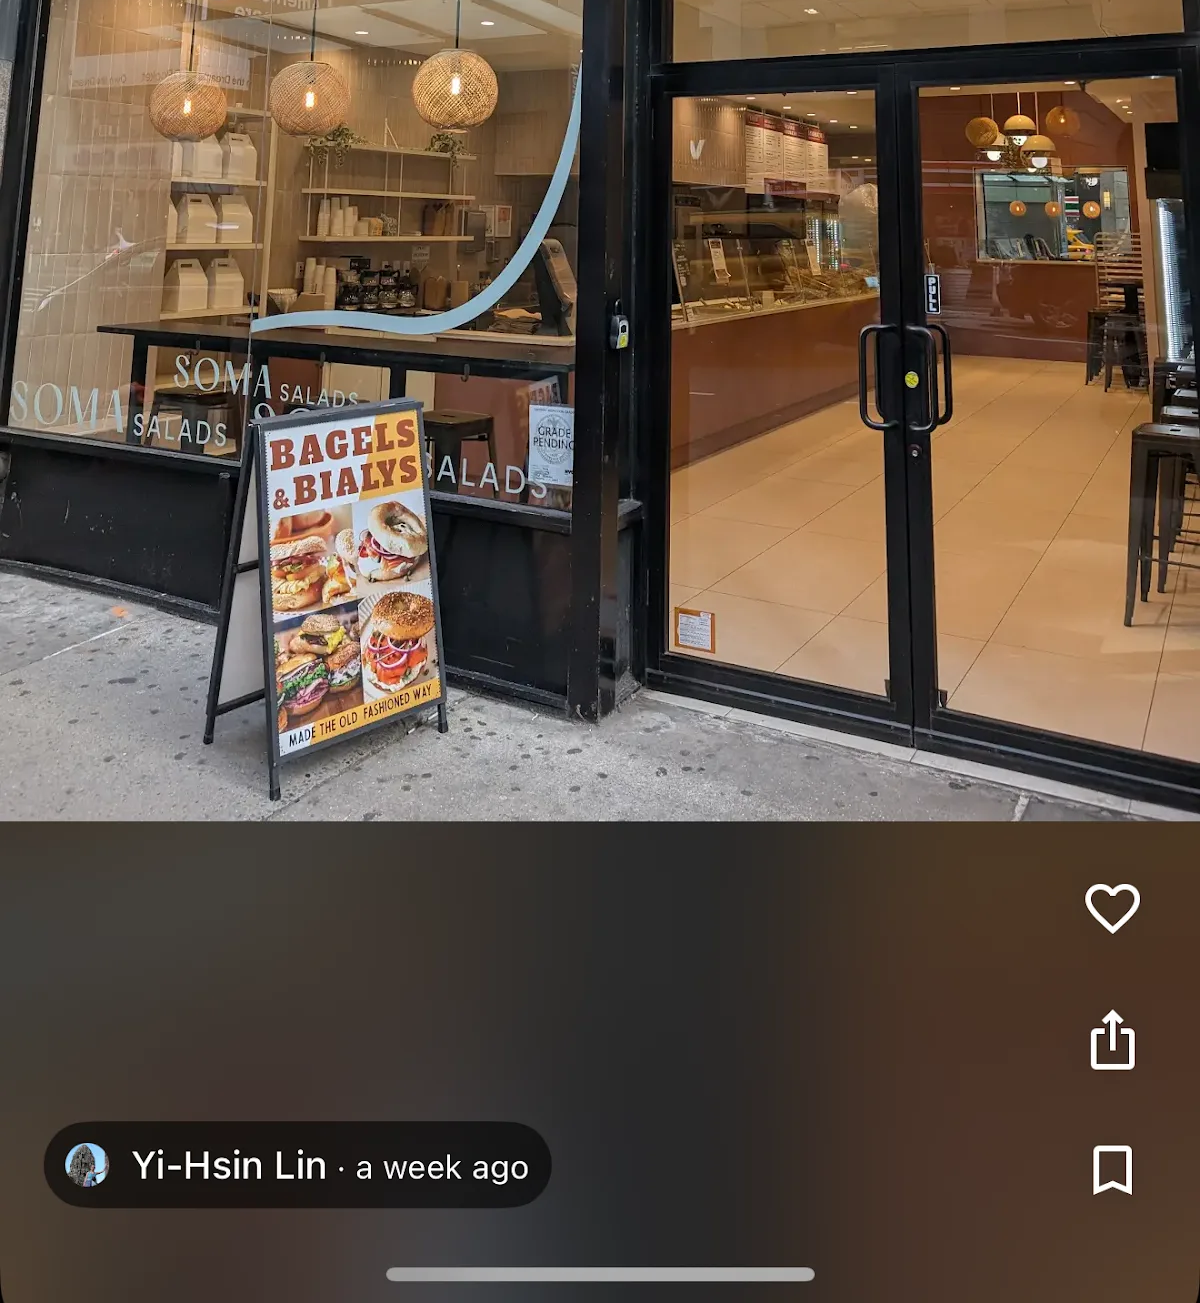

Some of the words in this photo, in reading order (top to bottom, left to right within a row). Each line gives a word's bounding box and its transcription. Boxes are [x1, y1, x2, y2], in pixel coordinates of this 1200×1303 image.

[928, 276, 938, 311] PULL
[173, 354, 272, 399] SOMA
[279, 383, 359, 408] SALADS
[9, 380, 123, 433] SOMA
[133, 413, 227, 447] SALADS
[538, 425, 571, 438] GRADE
[270, 418, 416, 471] BAGELS
[289, 726, 316, 747] MADE
[320, 720, 336, 736] THE
[339, 711, 358, 728] OLD
[363, 691, 410, 719] FASHIONED
[413, 684, 432, 700] WAY
